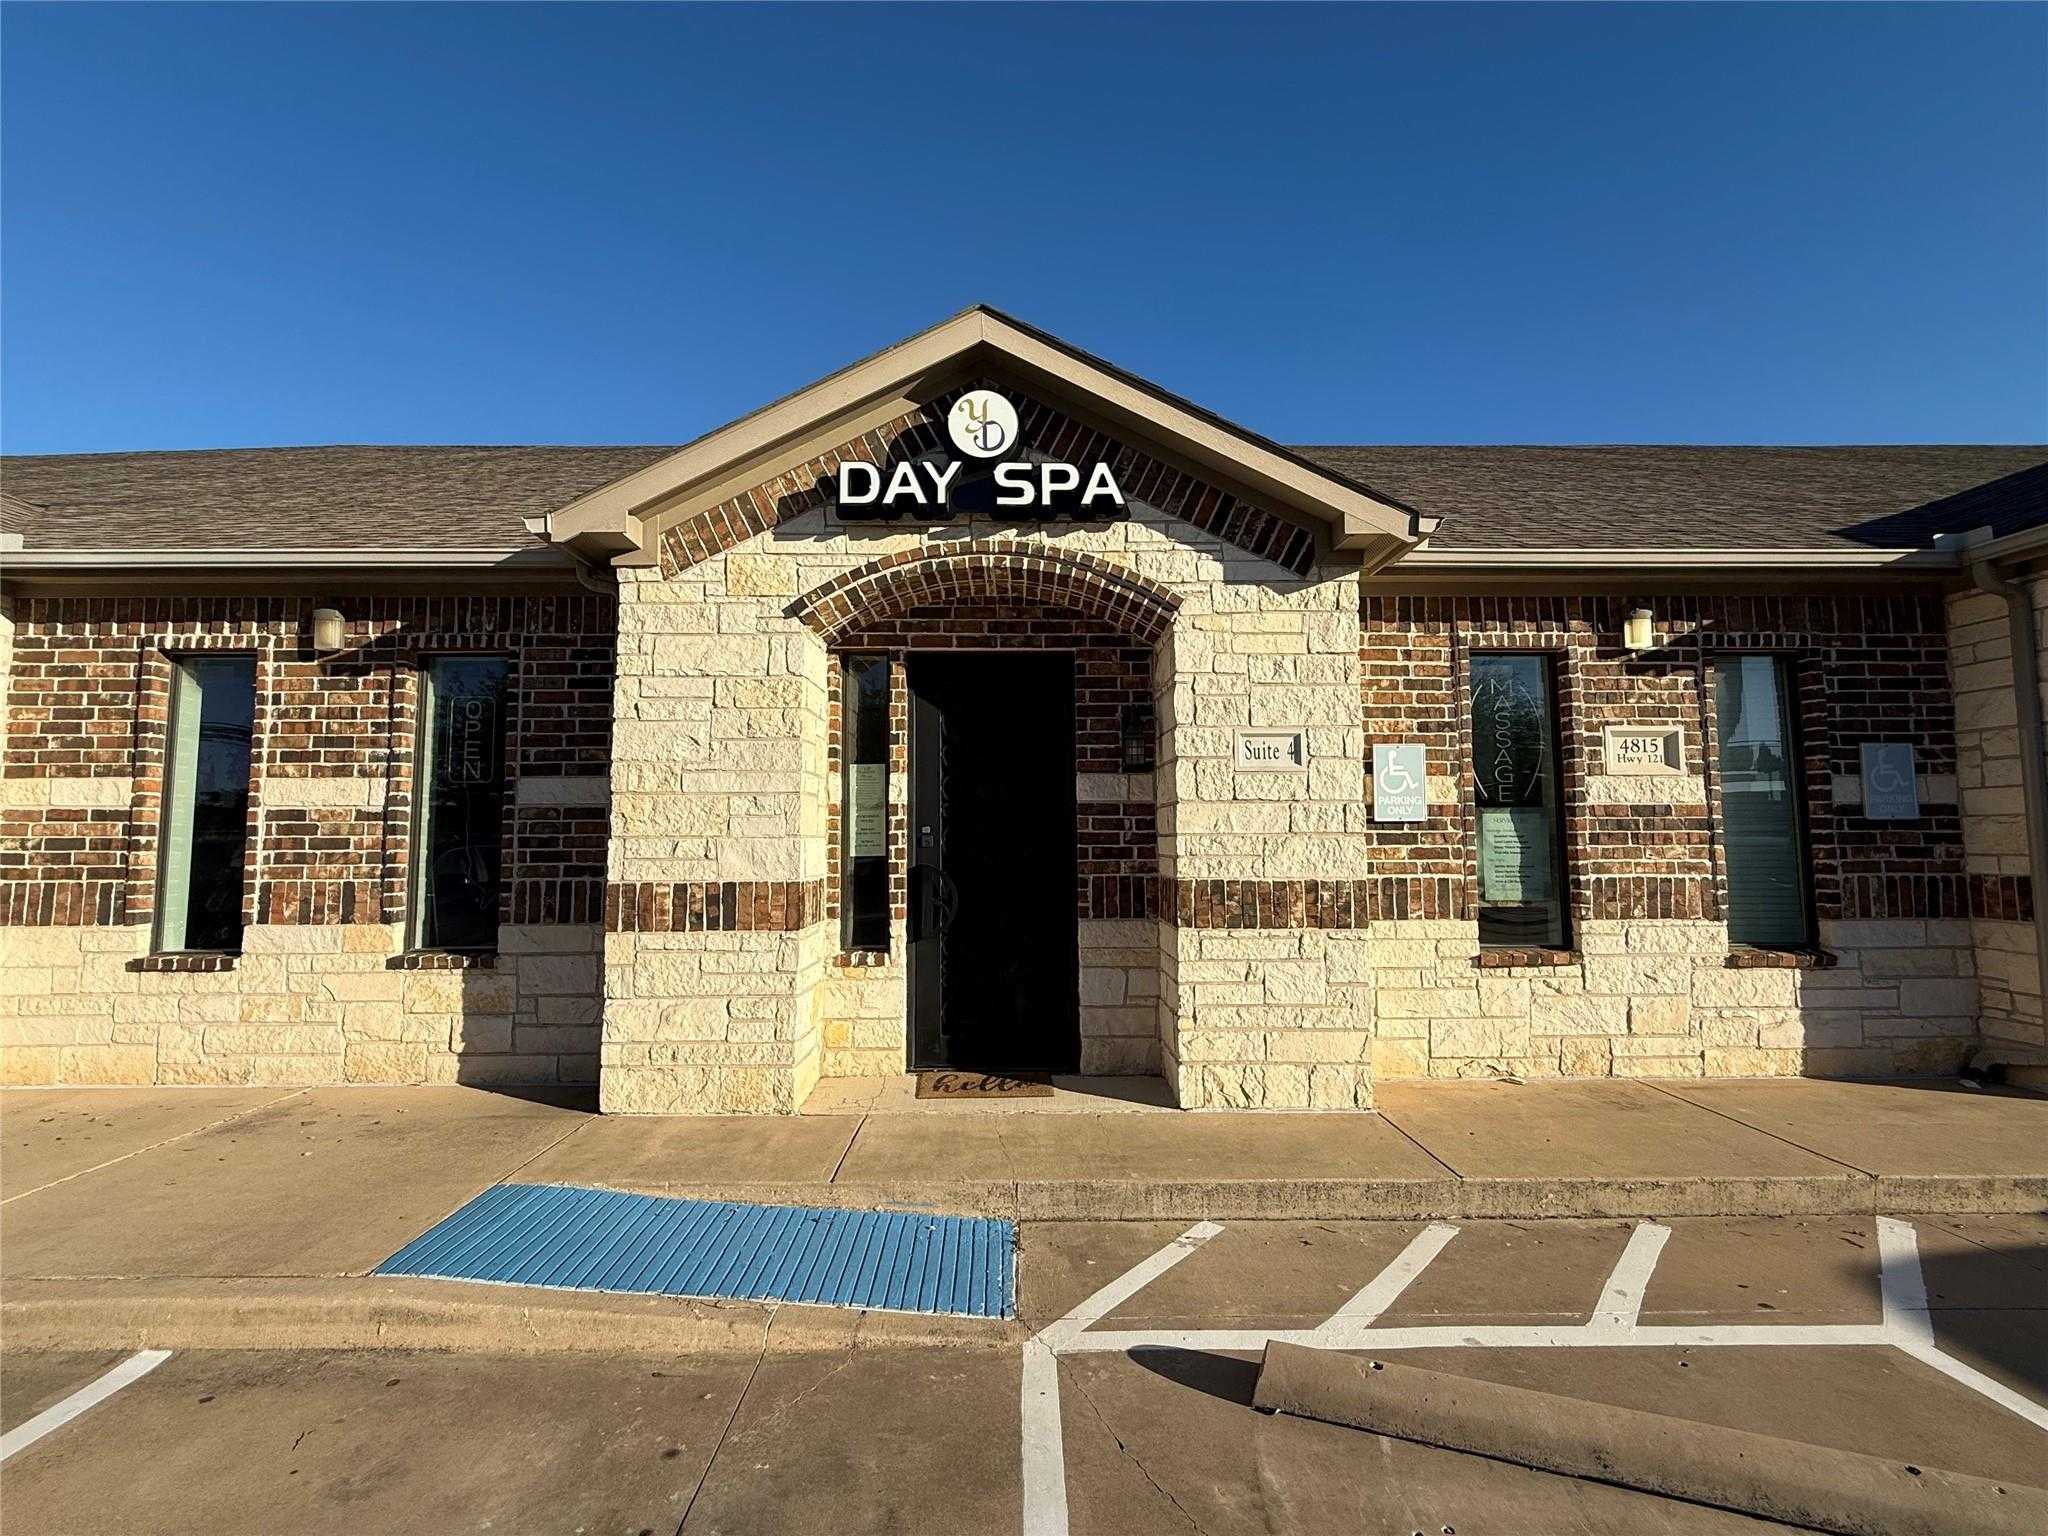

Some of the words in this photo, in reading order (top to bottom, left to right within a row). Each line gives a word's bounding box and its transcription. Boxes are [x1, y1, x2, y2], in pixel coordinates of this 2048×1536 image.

[839, 461, 962, 504] DAY
[993, 461, 1125, 506] SPA
[463, 702, 482, 779] OPEN
[1244, 740, 1280, 760] Suite
[1287, 741, 1295, 760] 4
[1490, 678, 1514, 803] MASSAGE
[1619, 738, 1659, 754] 4815
[1617, 753, 1643, 764] Hwy
[1647, 754, 1664, 764] 121
[1387, 805, 1414, 815] ONLY
